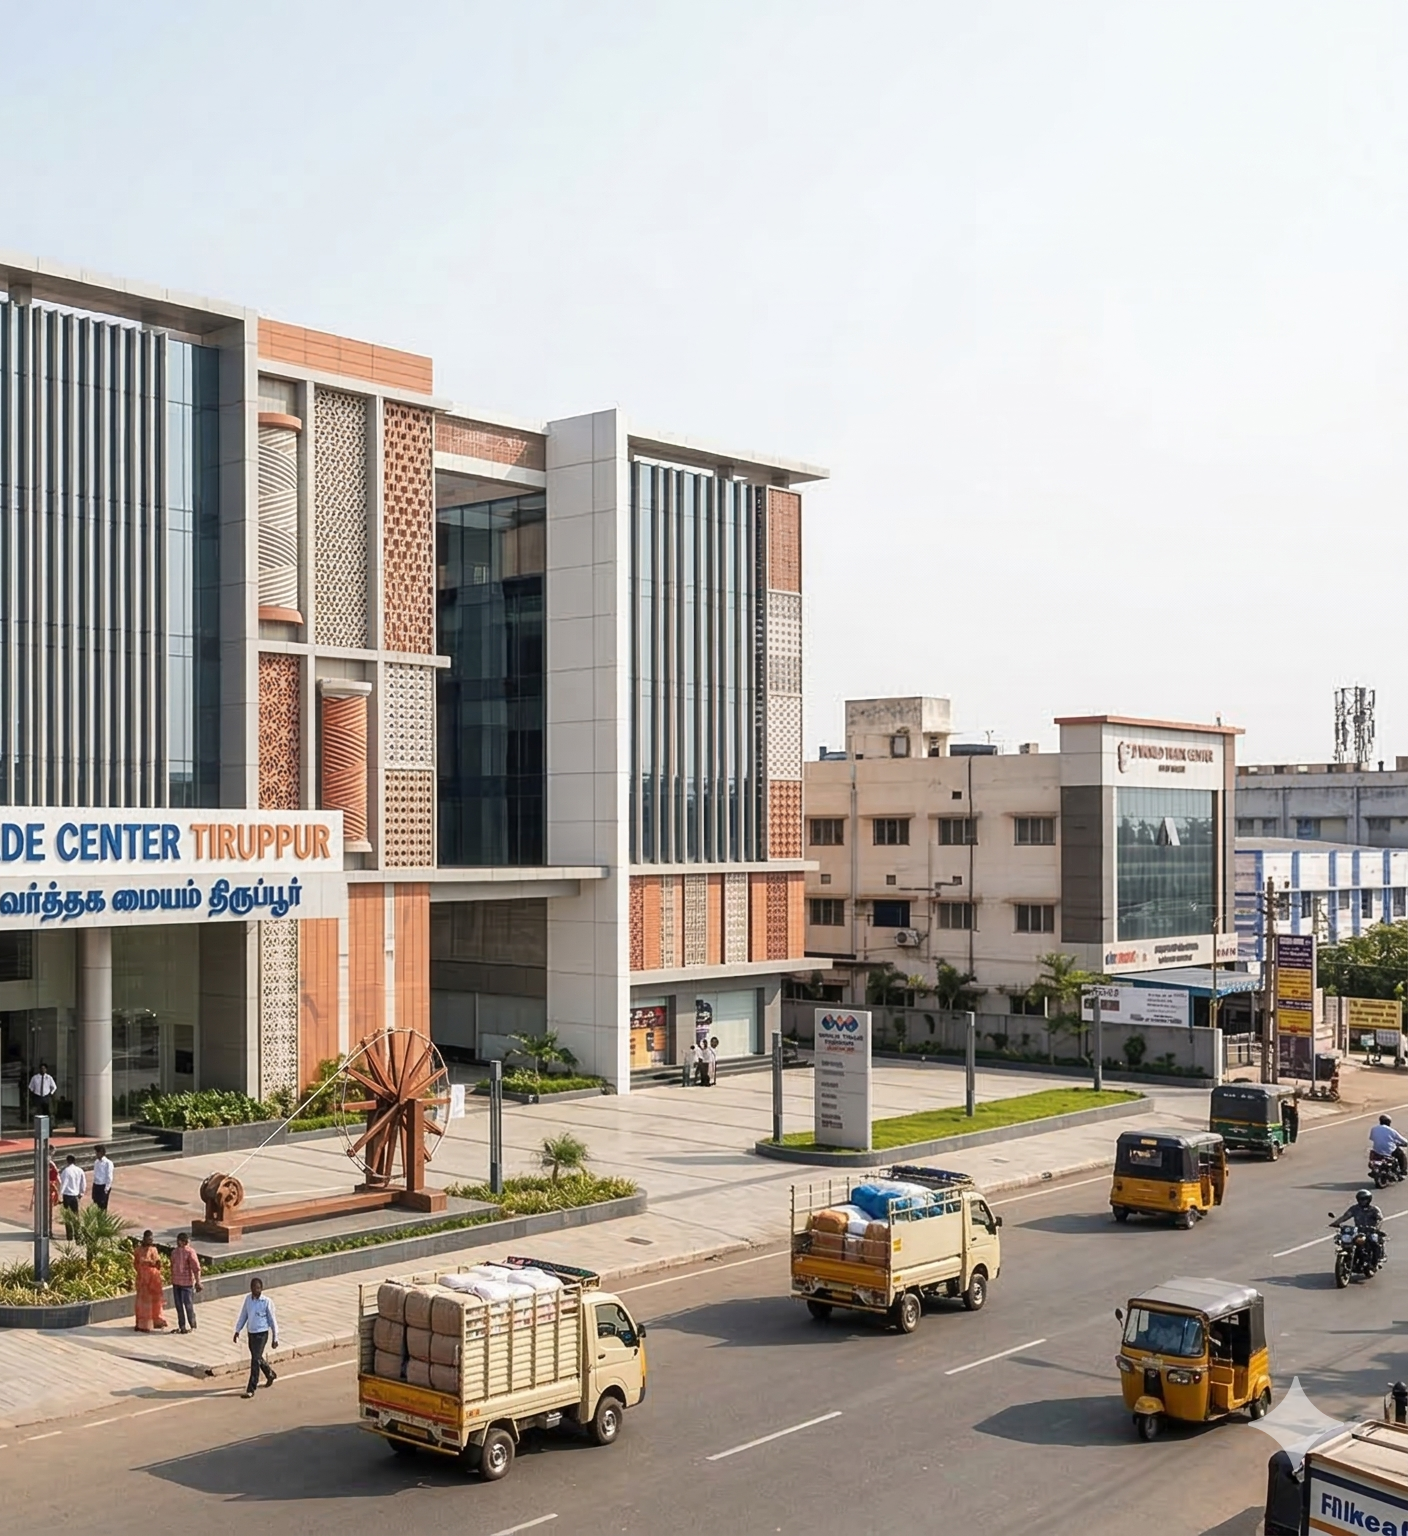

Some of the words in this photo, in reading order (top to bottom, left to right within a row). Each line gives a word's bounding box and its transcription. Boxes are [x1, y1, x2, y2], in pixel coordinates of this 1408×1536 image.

[56, 823, 180, 861] CENTER
[191, 823, 331, 861] TIRUPPUR
[112, 879, 202, 912] மையம்
[208, 876, 303, 917] திருப்பூர்
